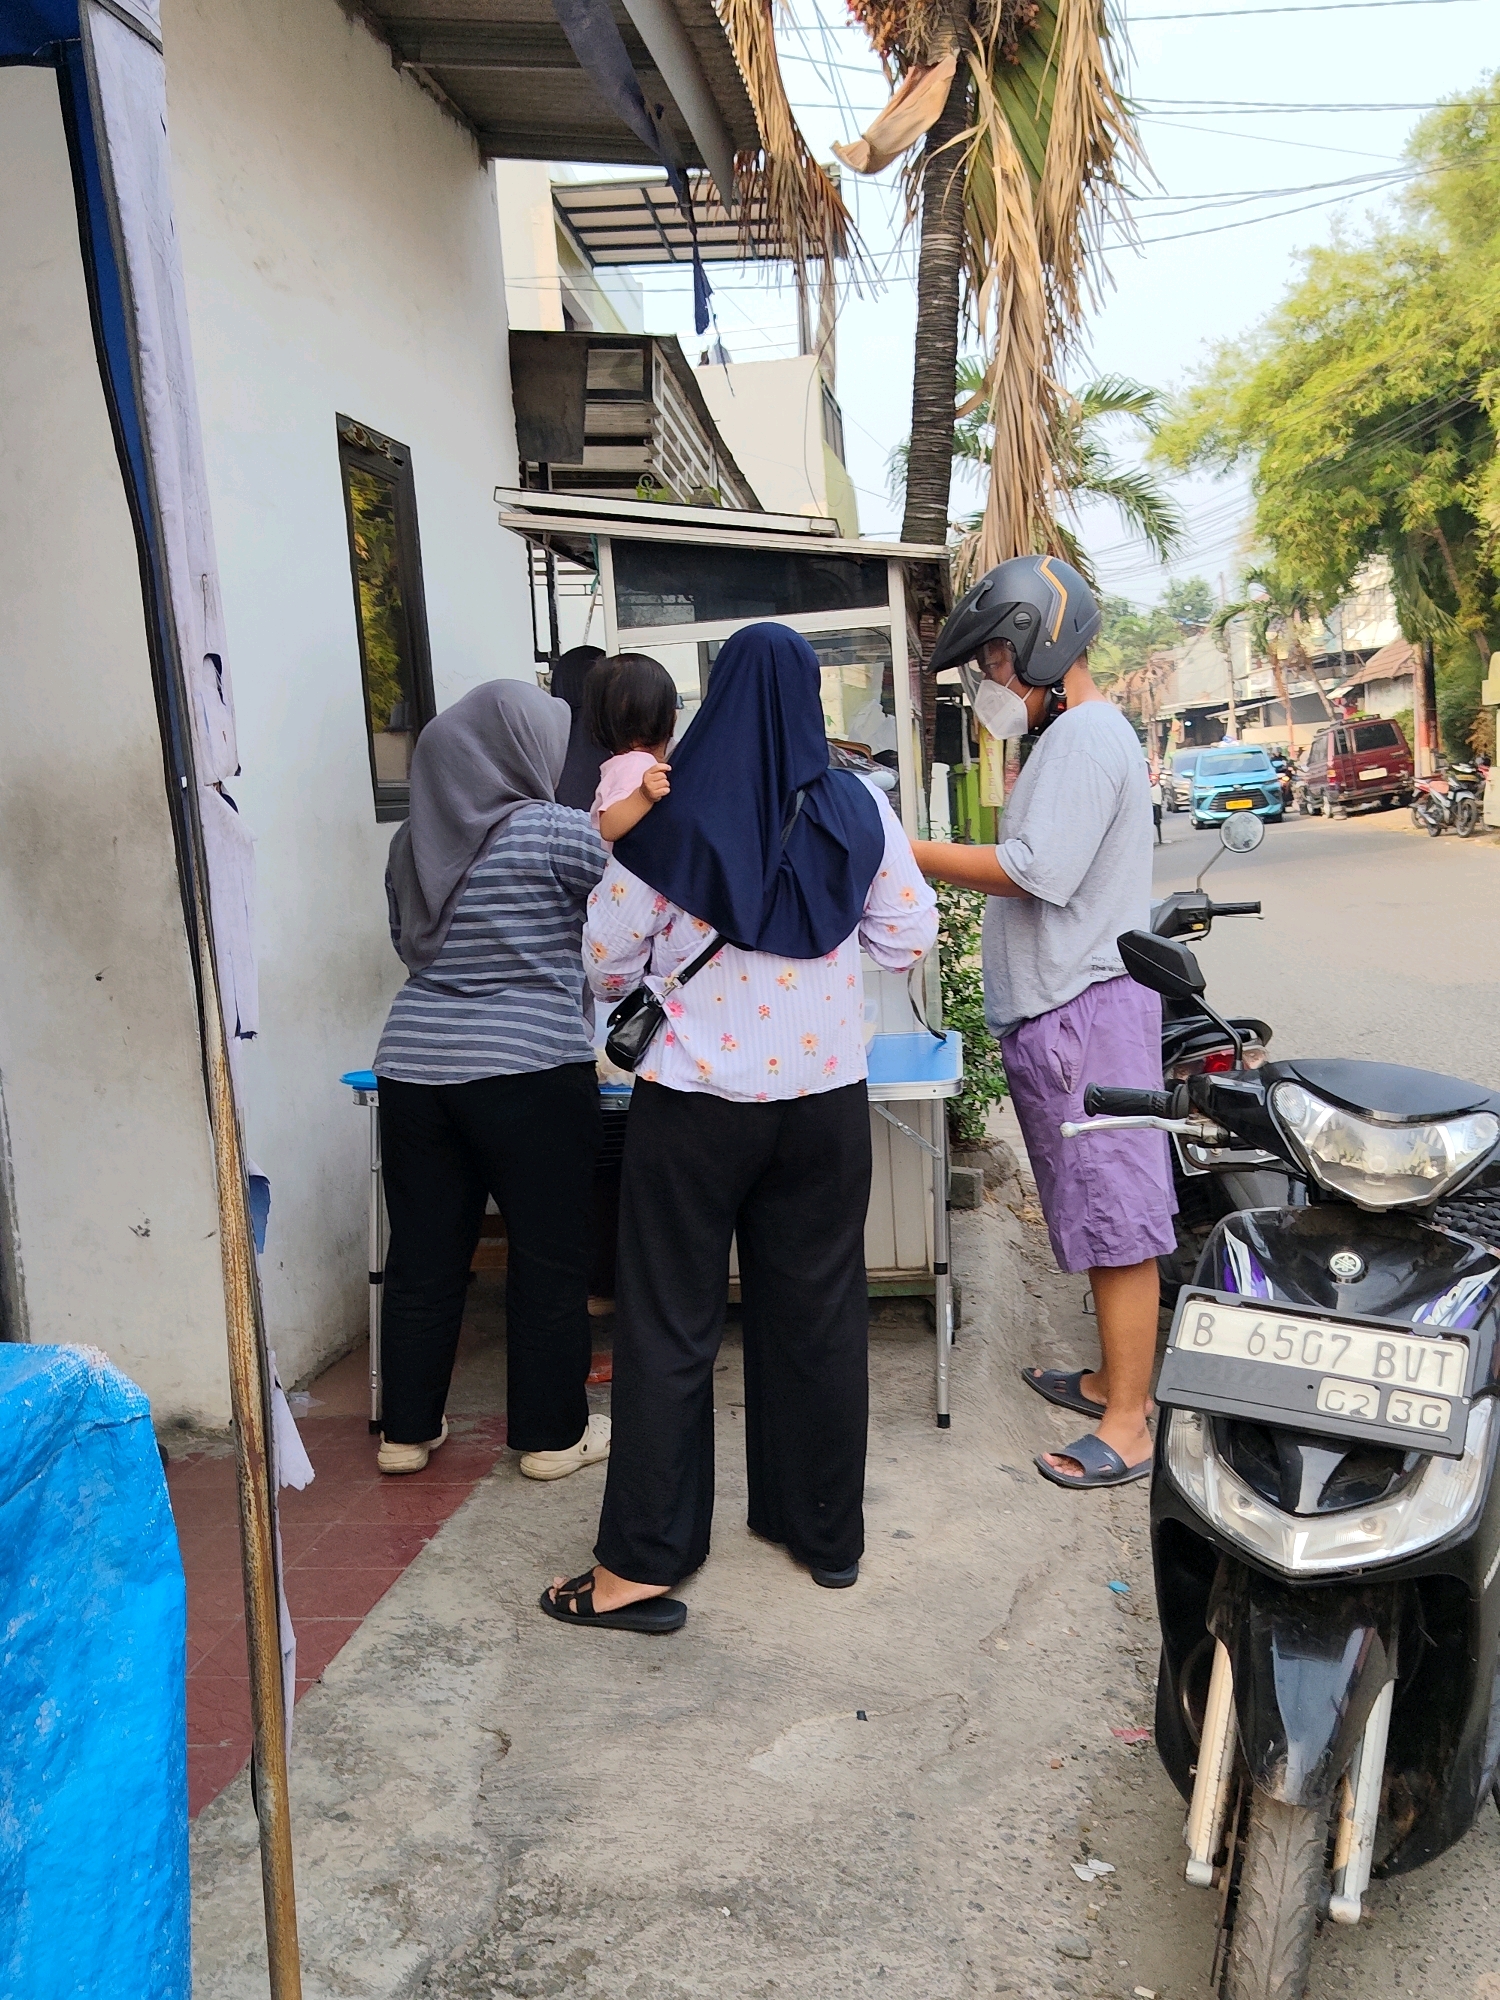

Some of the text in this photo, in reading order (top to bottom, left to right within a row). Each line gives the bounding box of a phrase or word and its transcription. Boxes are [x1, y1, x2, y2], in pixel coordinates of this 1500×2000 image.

[1193, 1312, 1454, 1388] B 6507 BVT
